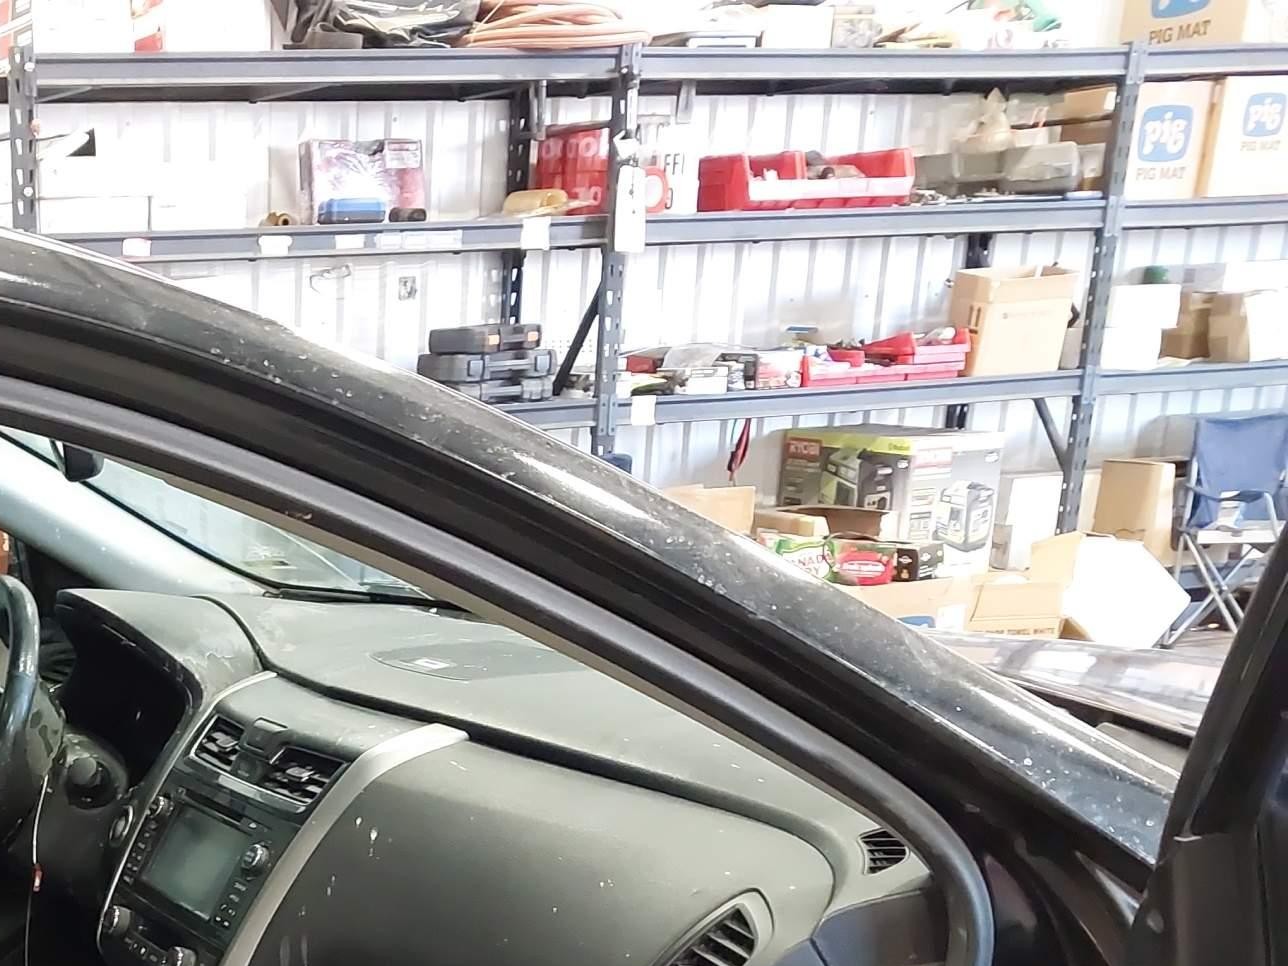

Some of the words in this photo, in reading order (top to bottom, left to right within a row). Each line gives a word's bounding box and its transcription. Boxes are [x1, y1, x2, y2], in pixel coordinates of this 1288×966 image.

[1148, 26, 1173, 45] PIG
[1177, 19, 1211, 41] MAT
[1247, 97, 1282, 131] pig
[1143, 111, 1188, 155] pig
[1135, 167, 1156, 181] PIG
[1159, 166, 1187, 180] MAT
